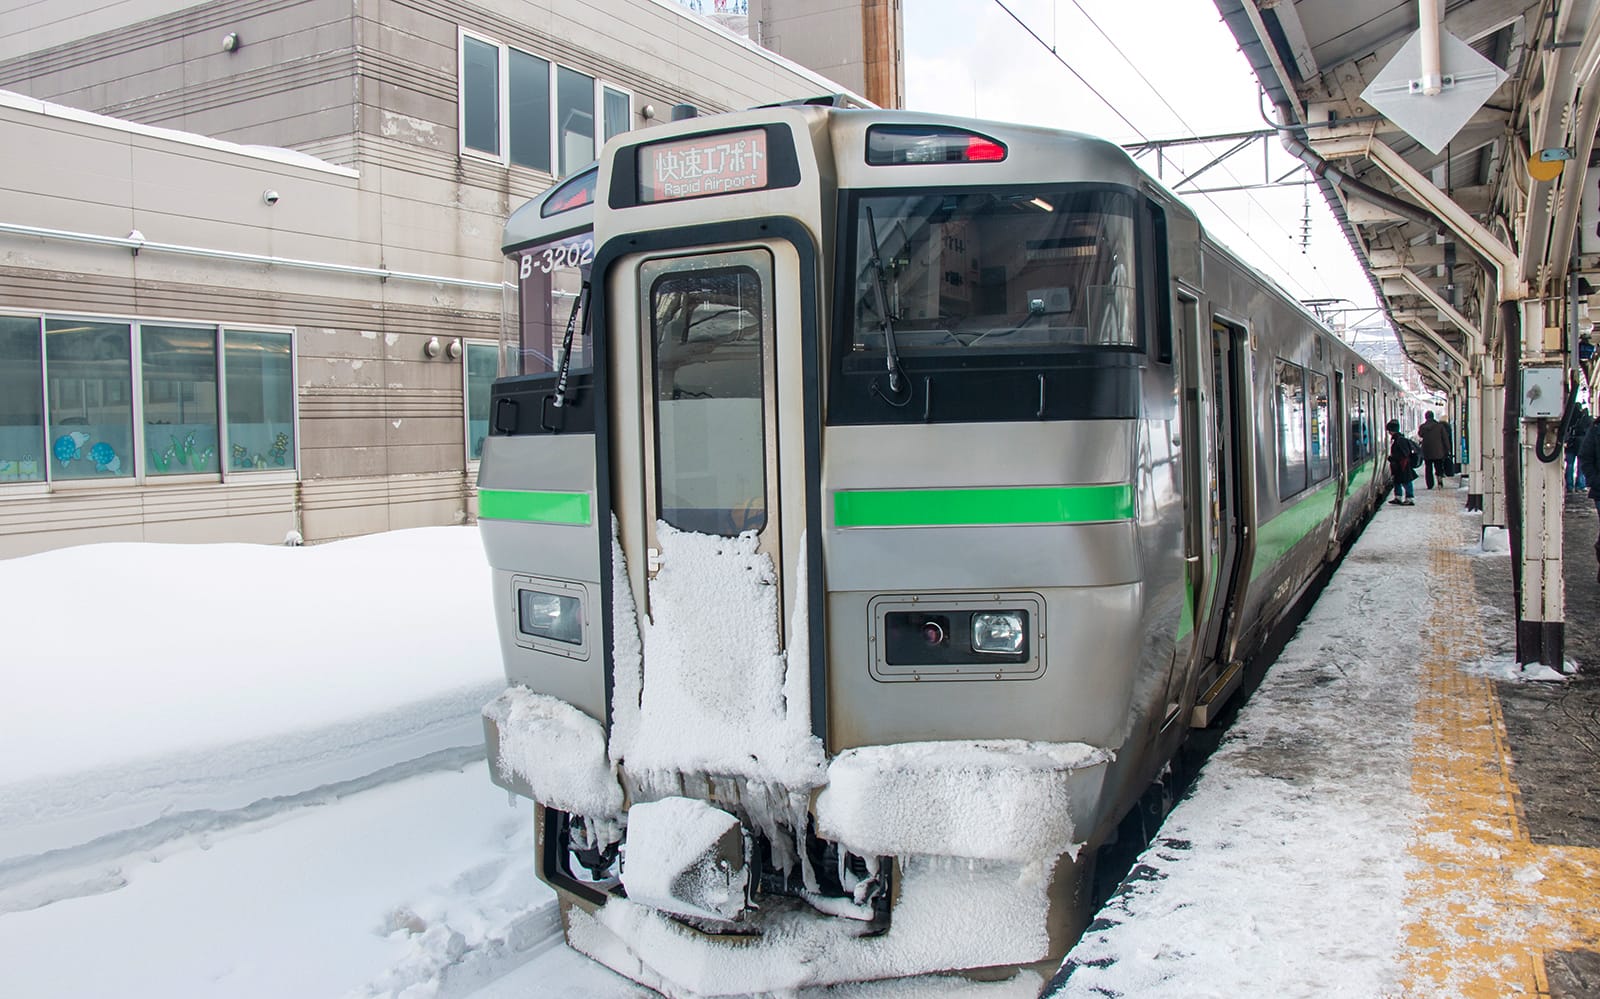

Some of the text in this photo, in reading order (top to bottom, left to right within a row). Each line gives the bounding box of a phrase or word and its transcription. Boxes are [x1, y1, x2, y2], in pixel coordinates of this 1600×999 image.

[655, 139, 764, 182] 快速エアポート
[664, 173, 758, 197] Rapid Airport
[519, 238, 594, 280] B-3202
